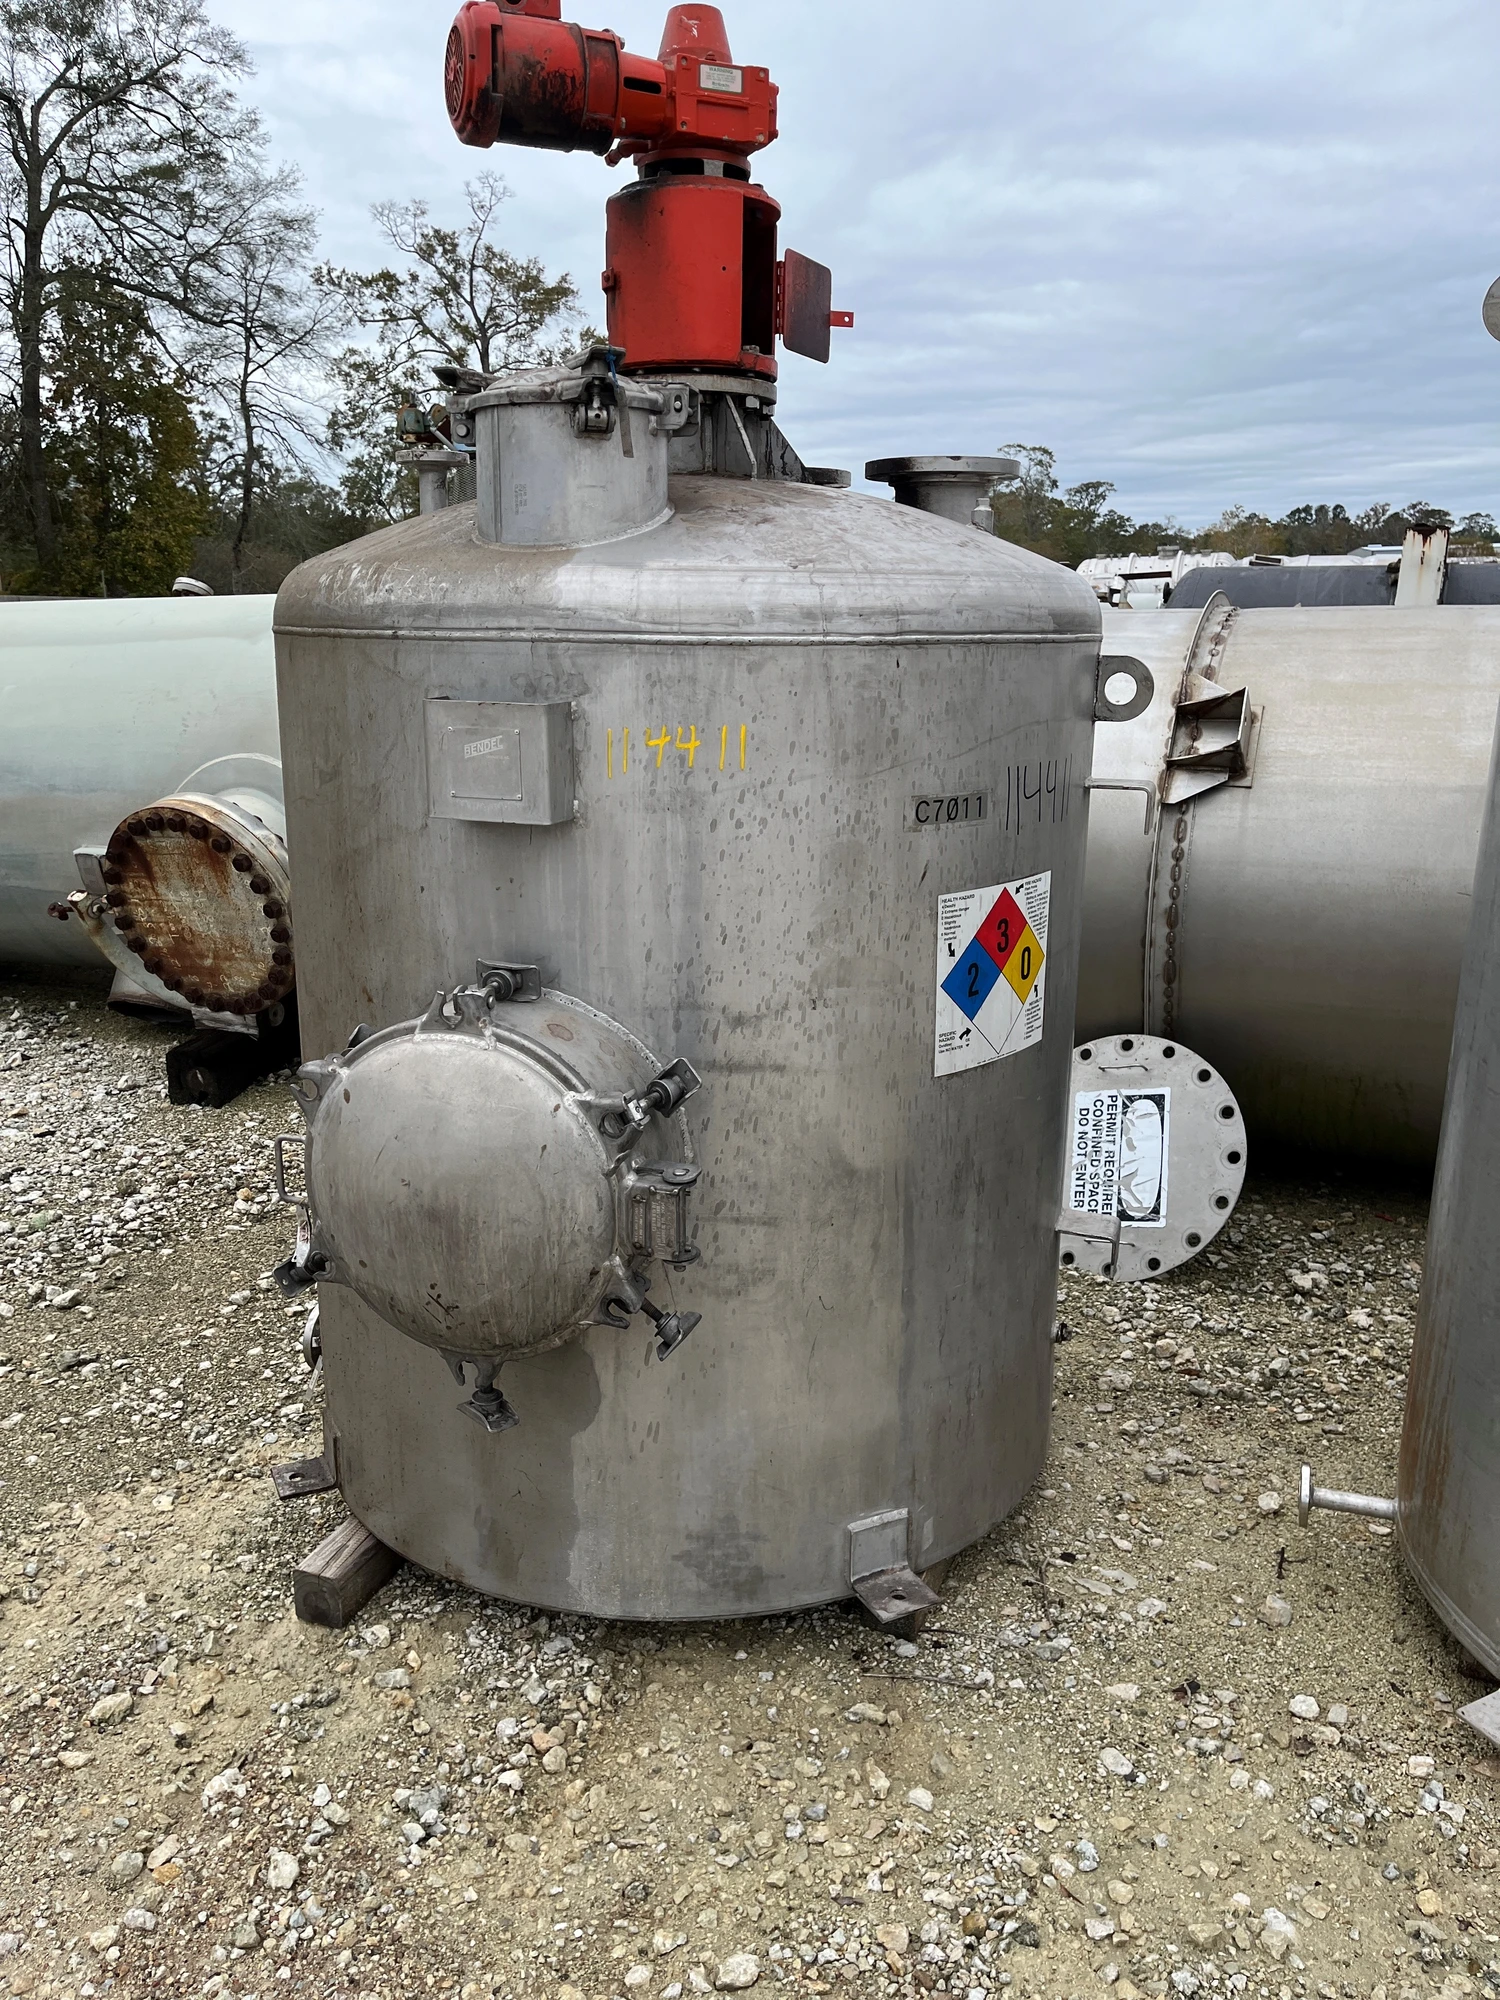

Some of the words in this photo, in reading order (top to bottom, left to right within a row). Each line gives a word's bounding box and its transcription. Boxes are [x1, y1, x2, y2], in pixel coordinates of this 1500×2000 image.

[464, 736, 503, 757] BENDEL
[996, 917, 1009, 953] 3
[967, 962, 980, 998] 2
[1020, 945, 1031, 981] 0
[939, 1030, 957, 1038] SPECIFIC
[1079, 1107, 1090, 1127] DO
[1090, 1099, 1104, 1168] CONFINED
[1105, 1094, 1118, 1146] PERMIT
[1076, 1131, 1089, 1159] NOT
[1073, 1163, 1087, 1209] ENTER
